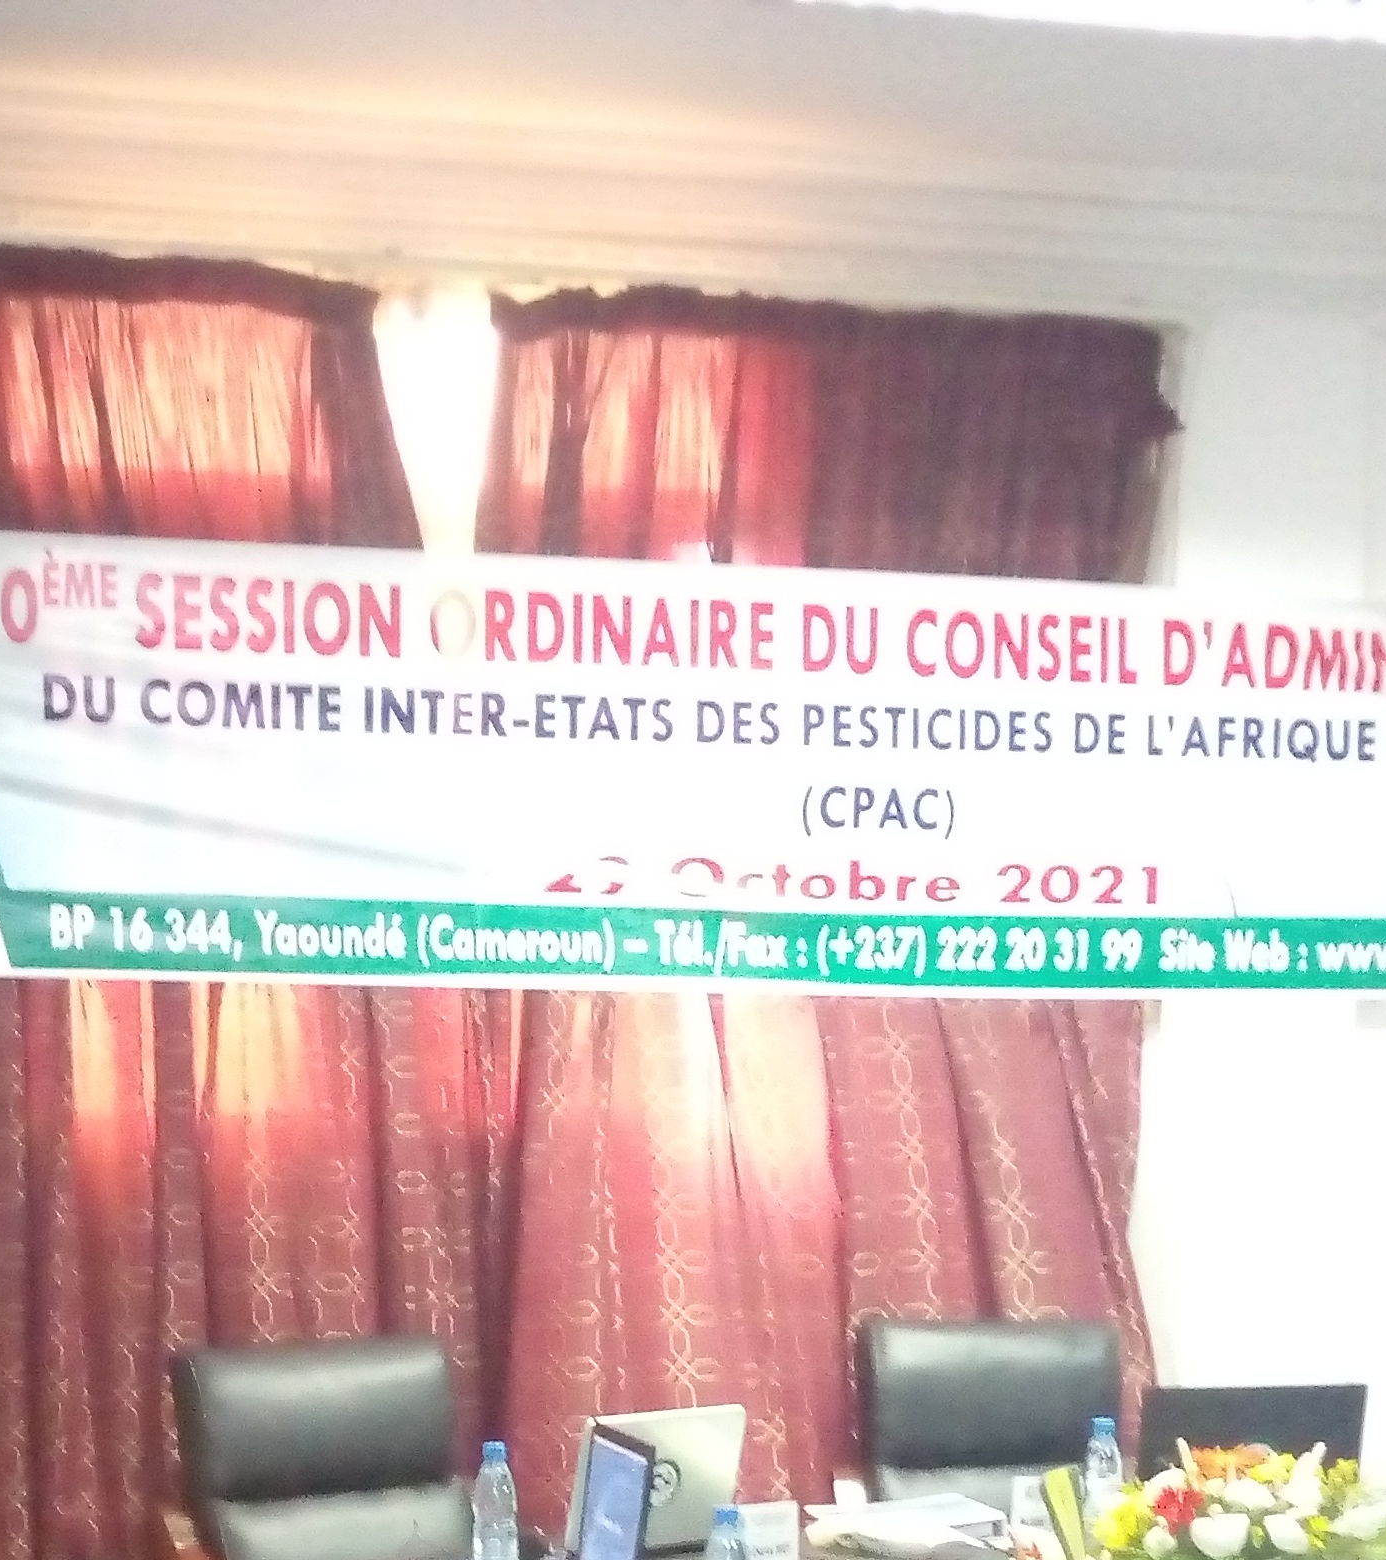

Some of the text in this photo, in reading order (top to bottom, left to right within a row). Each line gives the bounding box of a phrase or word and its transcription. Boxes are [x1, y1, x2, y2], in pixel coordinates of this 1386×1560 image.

[135, 571, 401, 658] SESSION
[430, 589, 774, 670] ORDINAIRE
[803, 603, 878, 675] DU
[907, 608, 1138, 684] CONSEIL
[43, 672, 115, 727] DU
[140, 678, 341, 732] COMITE
[364, 687, 673, 742] INTER-ETATS
[697, 700, 779, 745] DES
[804, 704, 1052, 753] PESTICIDES
[1074, 713, 1125, 755] DE
[1148, 715, 1376, 763] L'AFRIQUE
[803, 786, 954, 840] (CPAC)
[997, 864, 1158, 904] 2021
[47, 905, 98, 950] BP
[111, 907, 153, 952] 16
[165, 908, 245, 961] 344,
[254, 909, 406, 958] Yaoundé
[418, 914, 616, 973] (Cameroun)
[818, 926, 925, 975] (+237)
[938, 927, 996, 970] 222
[1006, 927, 1046, 970] 20
[1055, 928, 1088, 970] 31
[1102, 929, 1142, 969] 99
[1160, 928, 1215, 971] Site
[1225, 929, 1290, 972] Web
